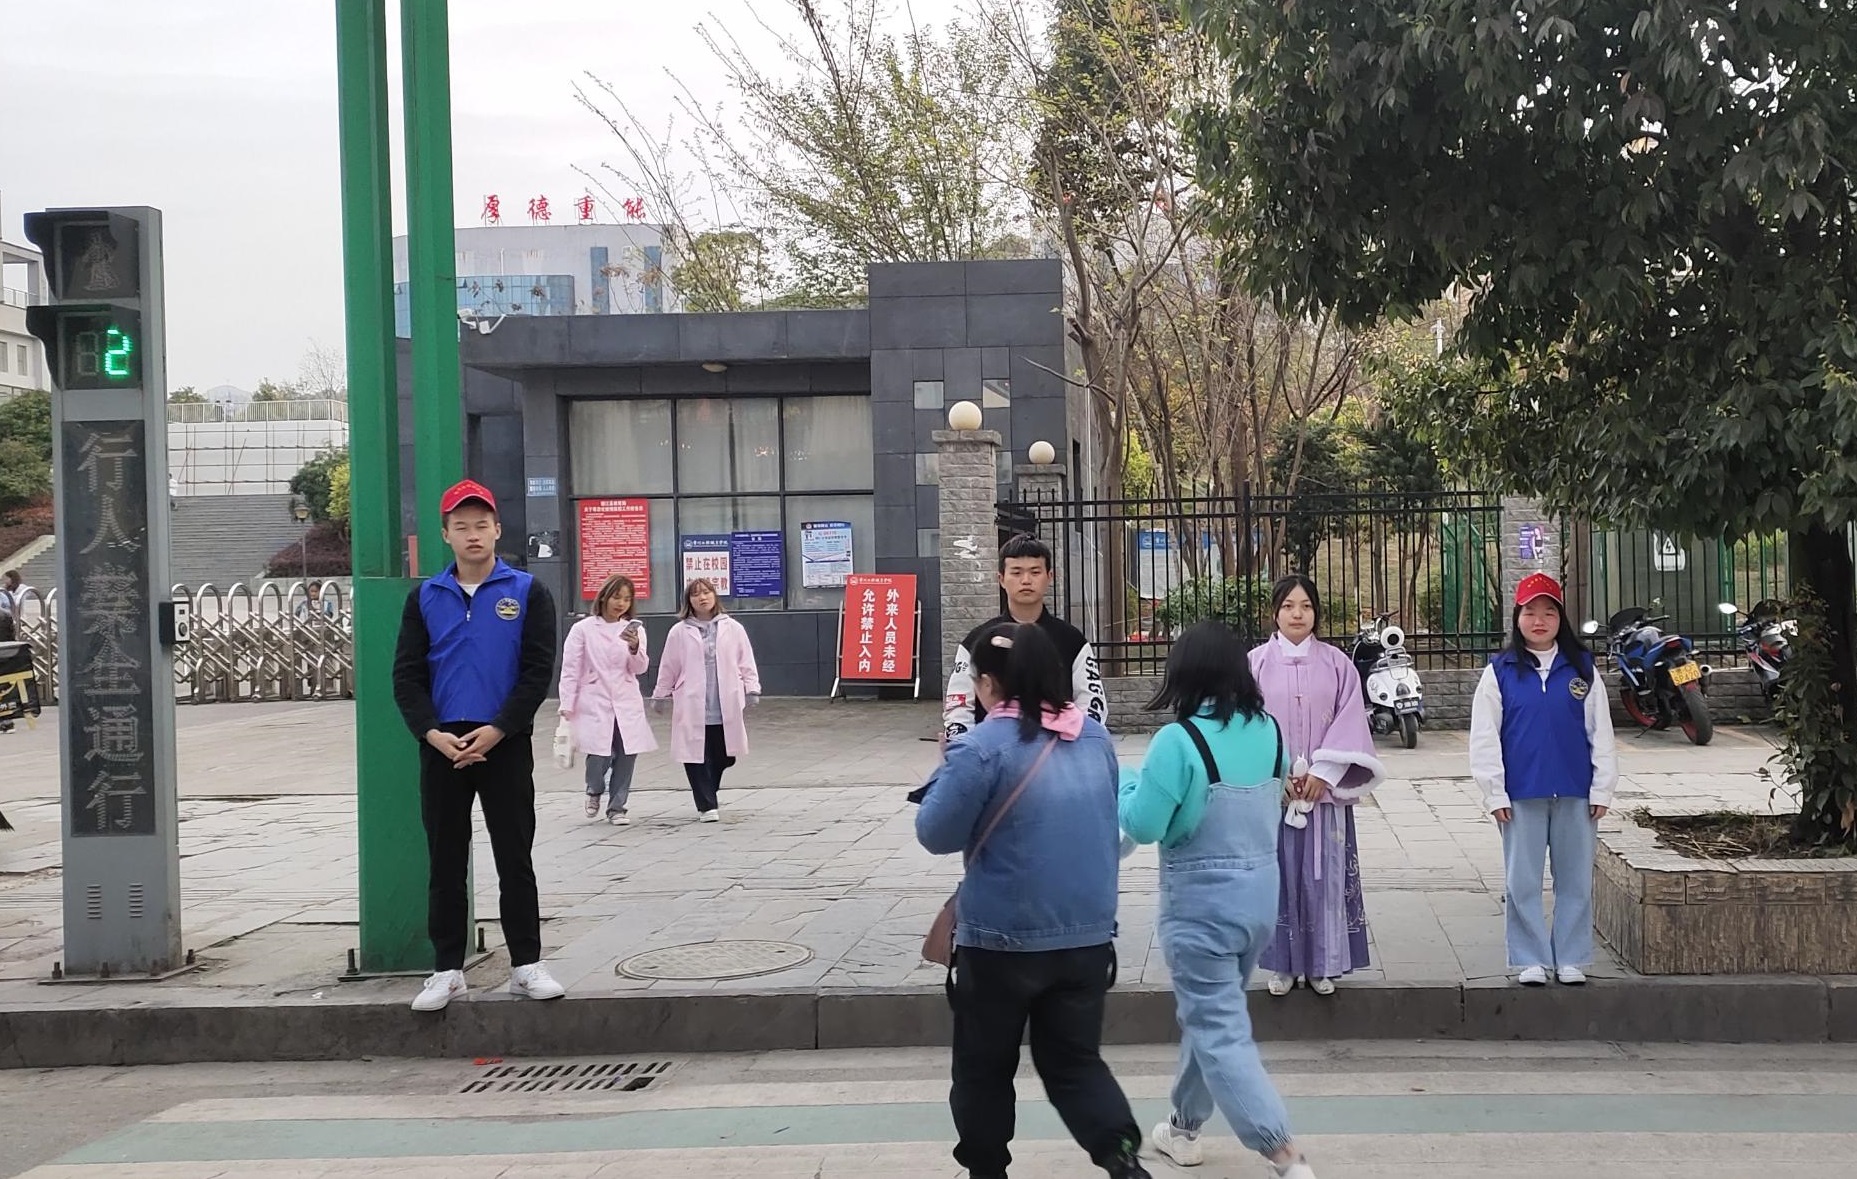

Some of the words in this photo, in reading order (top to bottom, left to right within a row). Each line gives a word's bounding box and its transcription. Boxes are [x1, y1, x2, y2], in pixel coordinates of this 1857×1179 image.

[104, 329, 130, 375] 2
[685, 556, 728, 572] 禁止在校园
[858, 588, 876, 673] 允许禁止入内
[881, 588, 900, 673] 外来人员未经
